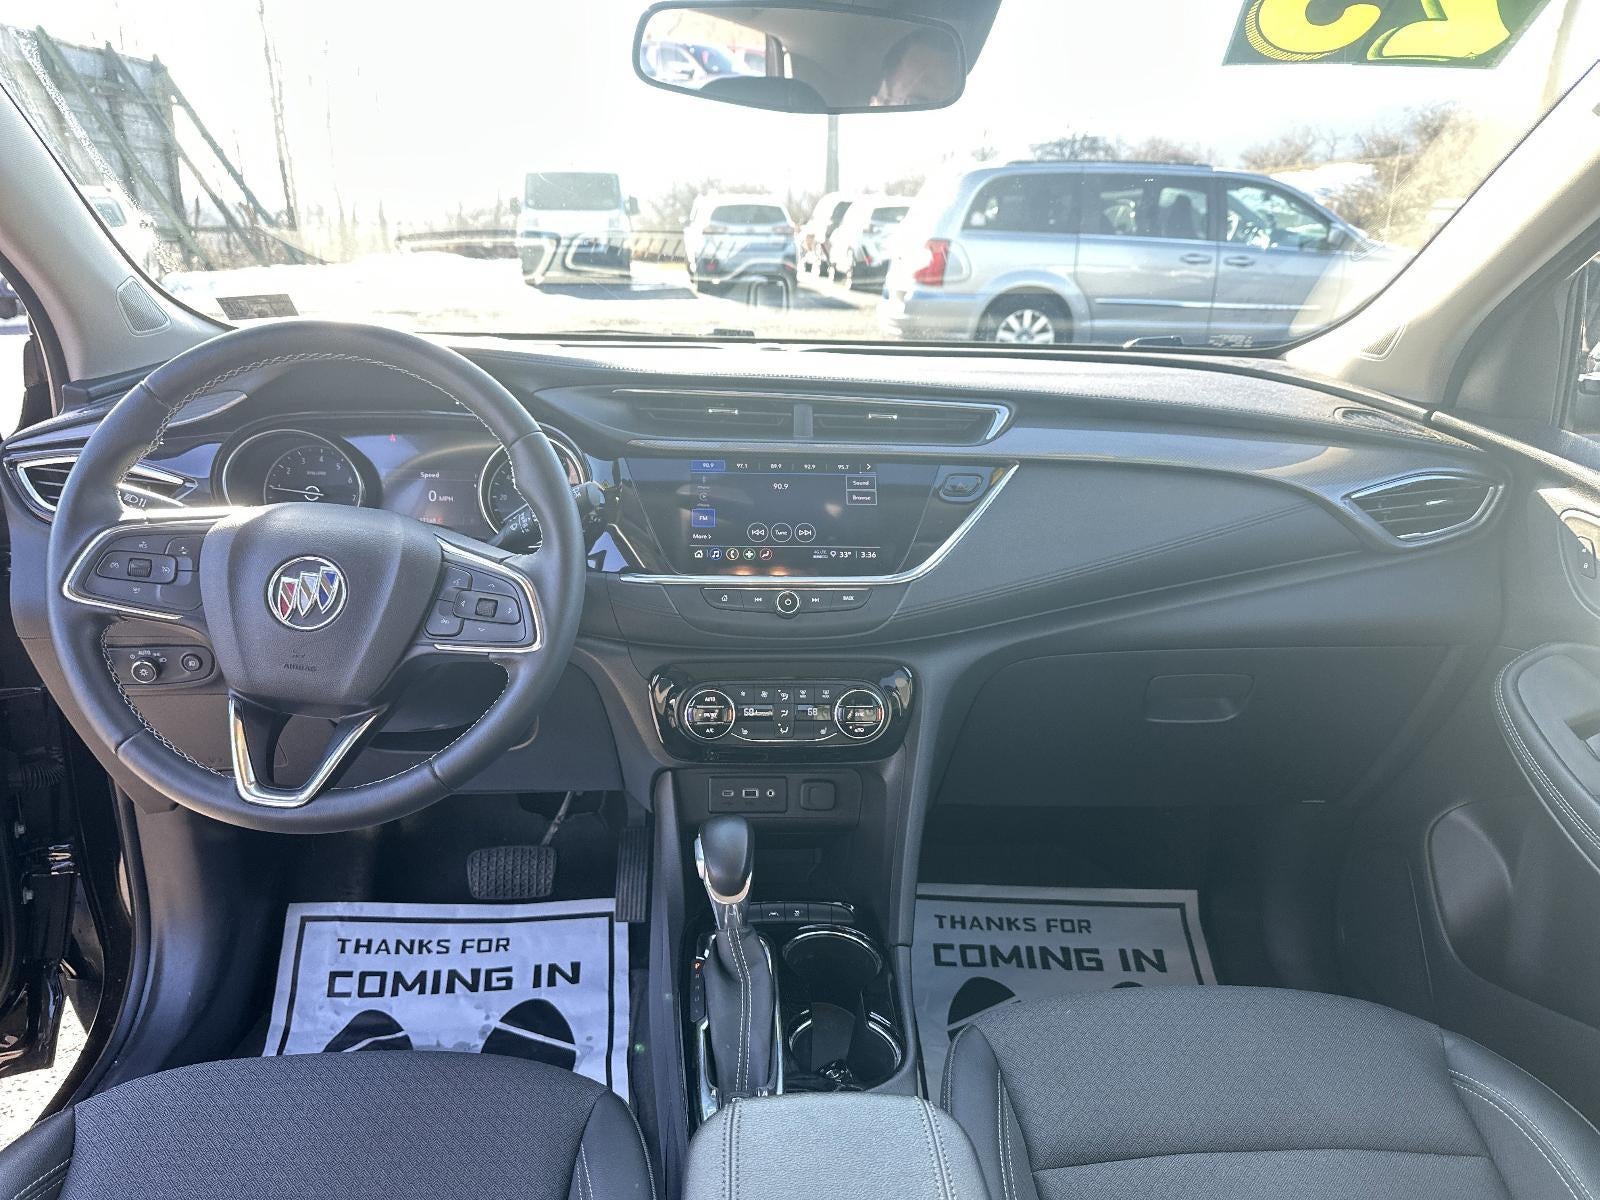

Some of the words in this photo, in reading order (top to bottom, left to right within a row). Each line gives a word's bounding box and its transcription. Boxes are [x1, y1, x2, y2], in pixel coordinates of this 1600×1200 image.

[420, 471, 440, 479] Speed
[773, 483, 789, 491] 90.9
[428, 490, 438, 502] 0
[860, 551, 877, 559] 3:36
[284, 663, 318, 672] AIRBAG
[933, 913, 1037, 933] THANKS
[1046, 917, 1092, 934] FOR
[337, 937, 451, 955] THANKS
[460, 936, 511, 954] FOR
[932, 942, 1105, 972] COMING
[1118, 947, 1168, 973] IN
[326, 965, 514, 998] COMING
[532, 960, 582, 989] IN
